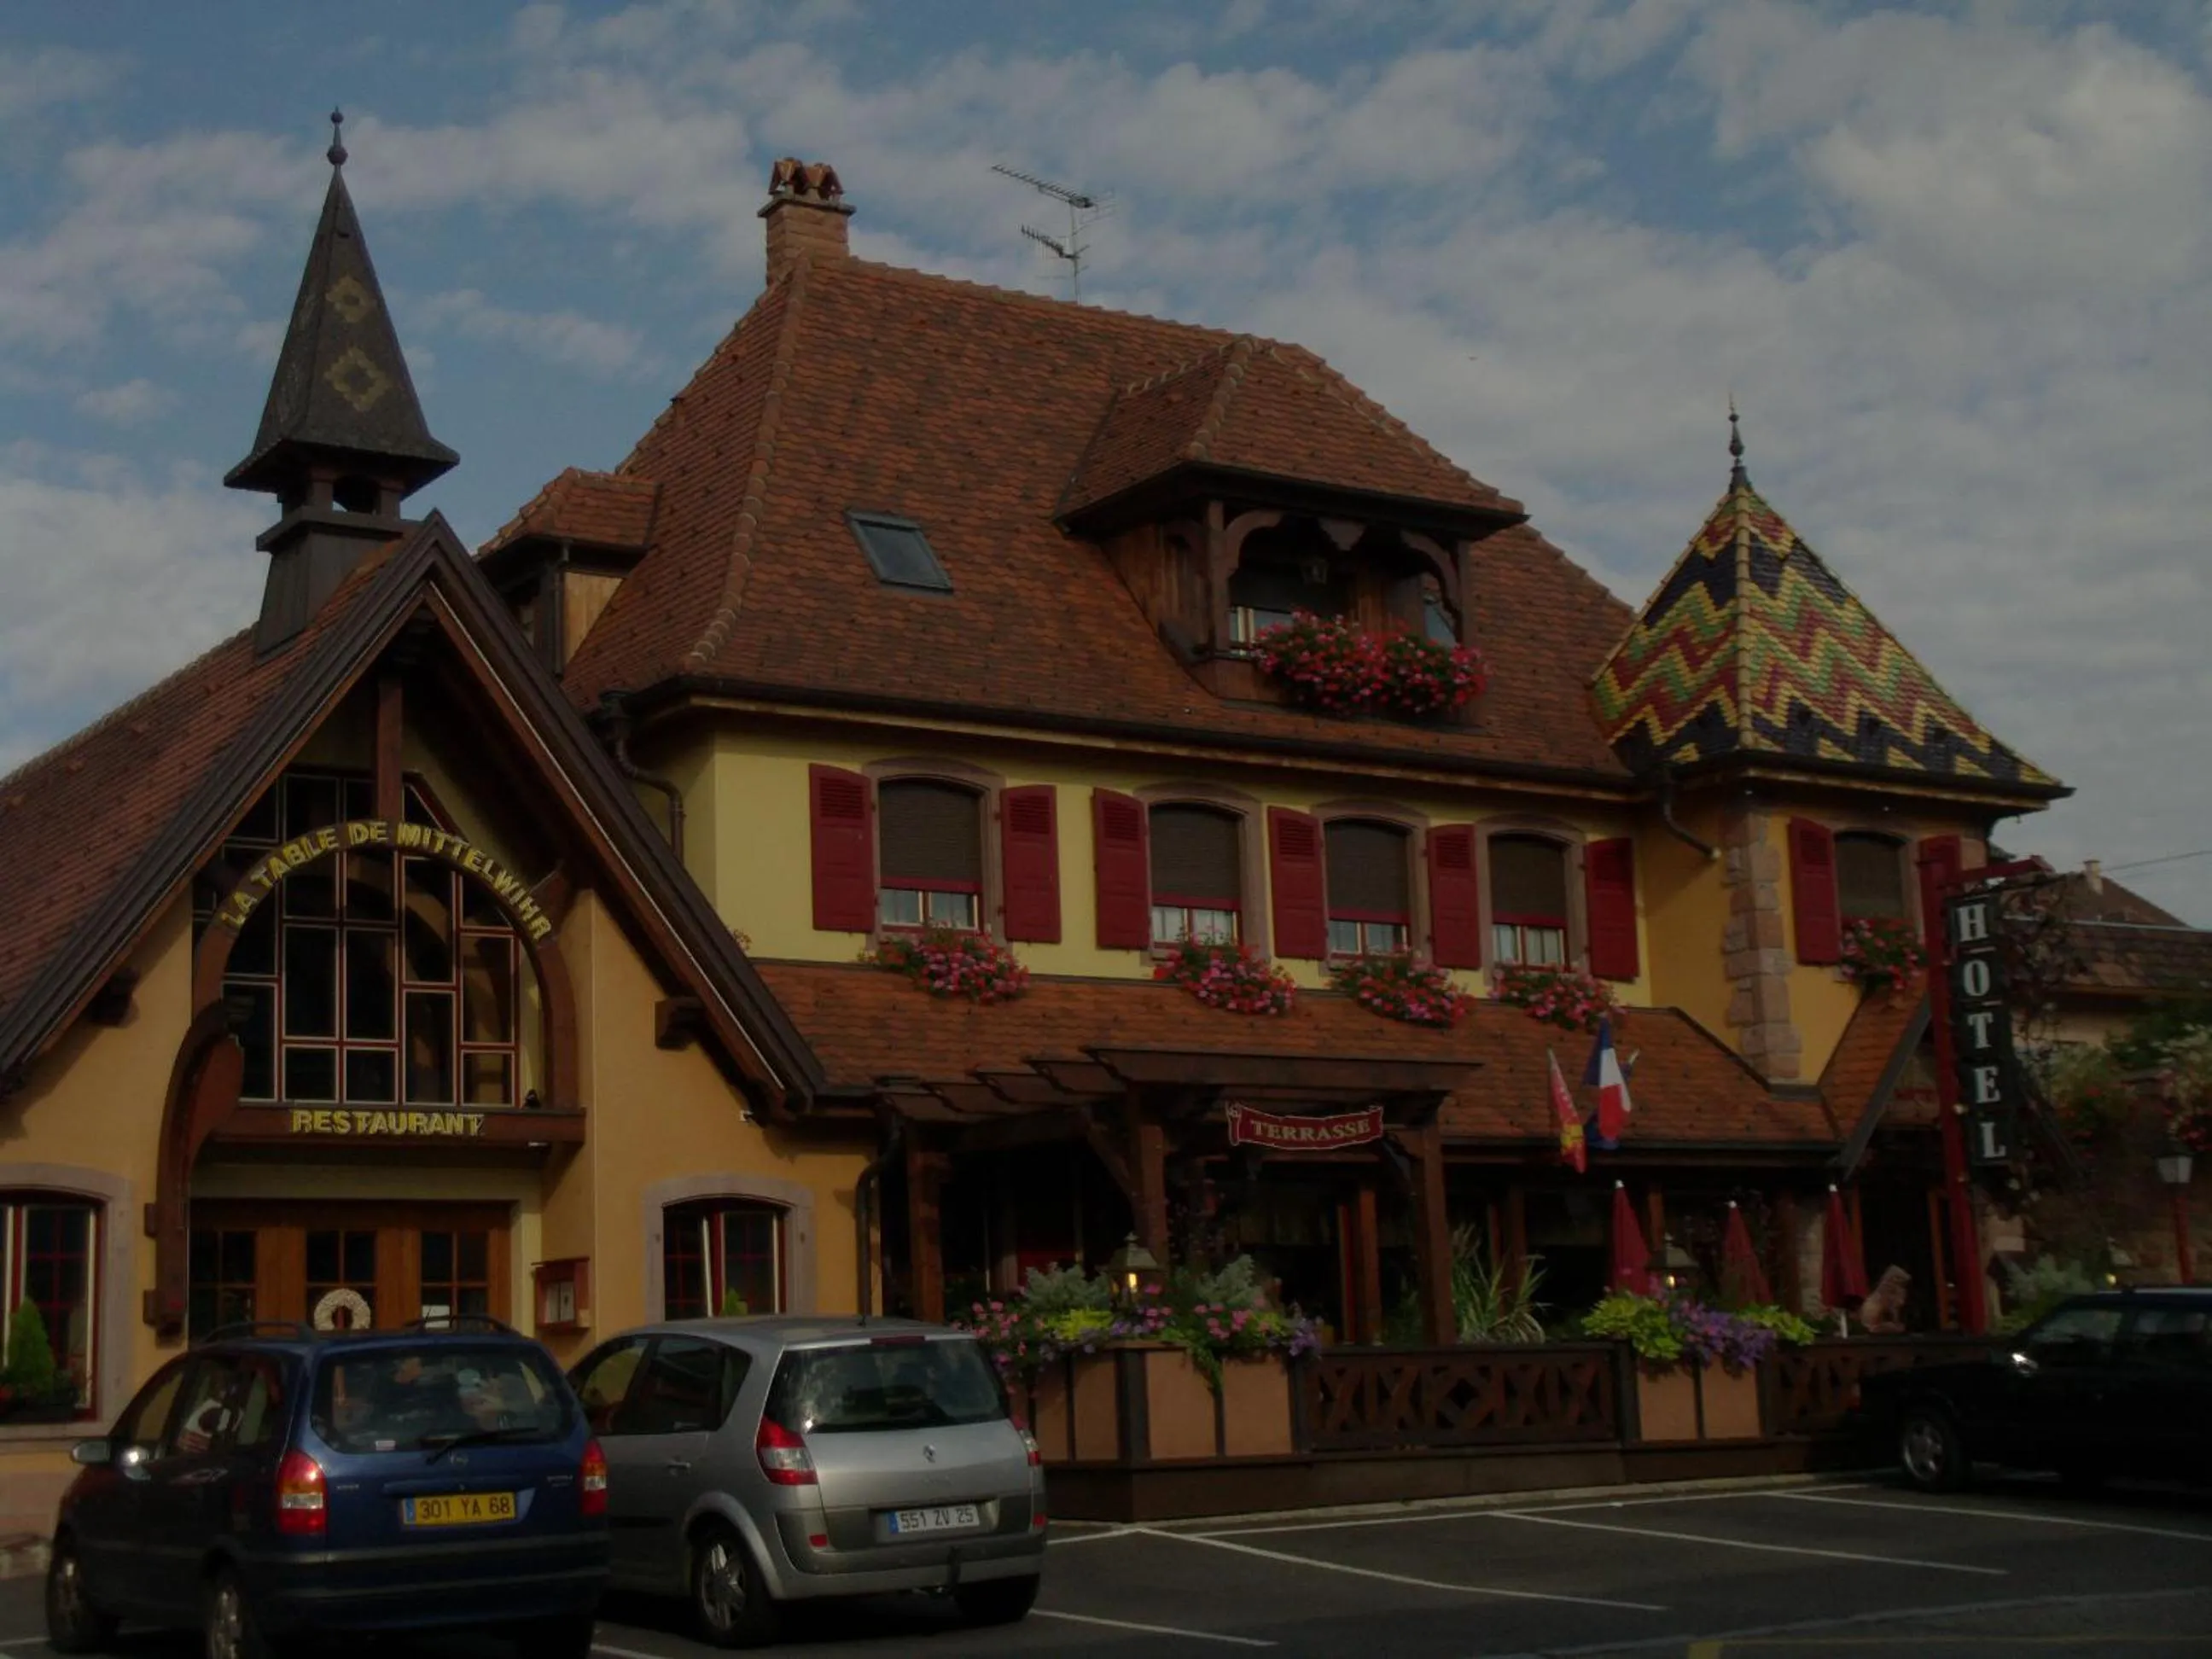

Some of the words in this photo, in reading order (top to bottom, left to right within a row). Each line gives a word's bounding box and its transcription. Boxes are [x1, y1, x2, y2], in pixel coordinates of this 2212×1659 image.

[220, 891, 258, 928] LA
[250, 828, 339, 889] TABLE
[347, 820, 389, 844] DE
[397, 822, 553, 941] MITTELWIHR
[1956, 902, 2006, 1160] HOTEL
[290, 1109, 485, 1137] RESTAURANT
[1250, 1119, 1371, 1141] TERRASSE
[418, 1499, 451, 1520] 301
[459, 1498, 482, 1517] YA
[488, 1496, 511, 1515] 68
[900, 1511, 927, 1529] 551
[956, 1506, 974, 1523] 25
